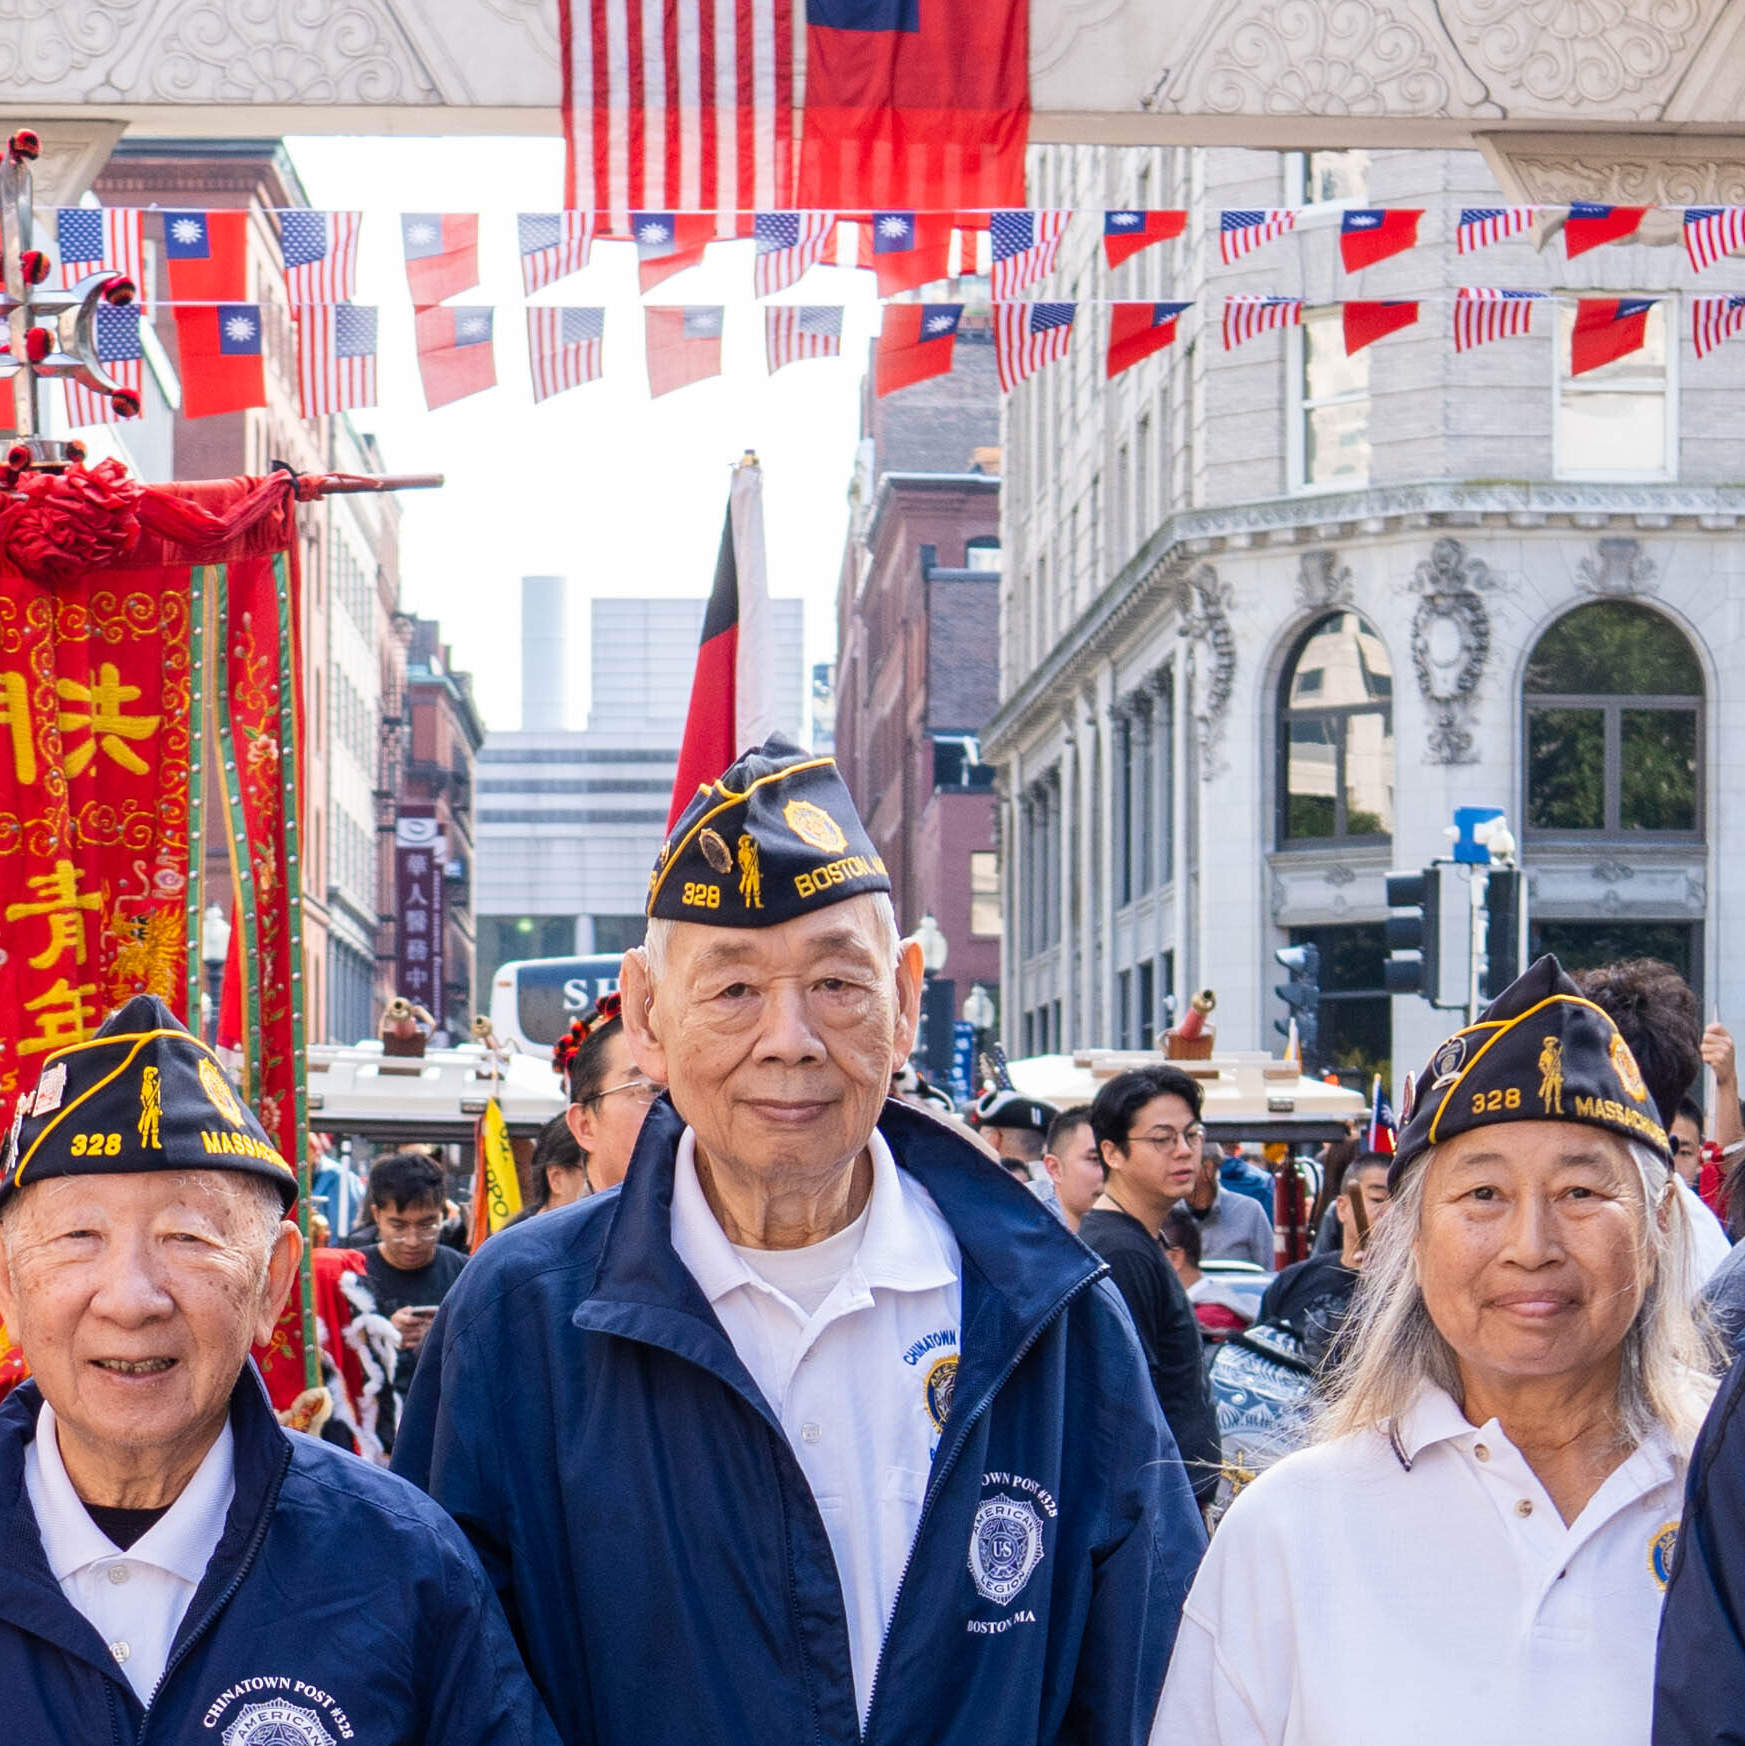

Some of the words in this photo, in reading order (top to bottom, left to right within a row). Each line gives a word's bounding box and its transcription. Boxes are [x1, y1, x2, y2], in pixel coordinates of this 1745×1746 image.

[794, 856, 874, 899] BOSTON,
[681, 882, 721, 909] 328
[1471, 1087, 1521, 1114] 328
[70, 1133, 122, 1157] 328
[903, 1330, 956, 1366] CHINATOWN
[1012, 1474, 1039, 1496] POST
[1036, 1488, 1059, 1519] #328
[973, 1505, 1036, 1535] AMERICAN
[980, 1571, 1025, 1594] LEGION
[1013, 1609, 1037, 1624] MA
[203, 1676, 292, 1729] CHINATOWN
[293, 1679, 337, 1709] POST
[329, 1707, 356, 1741] #328
